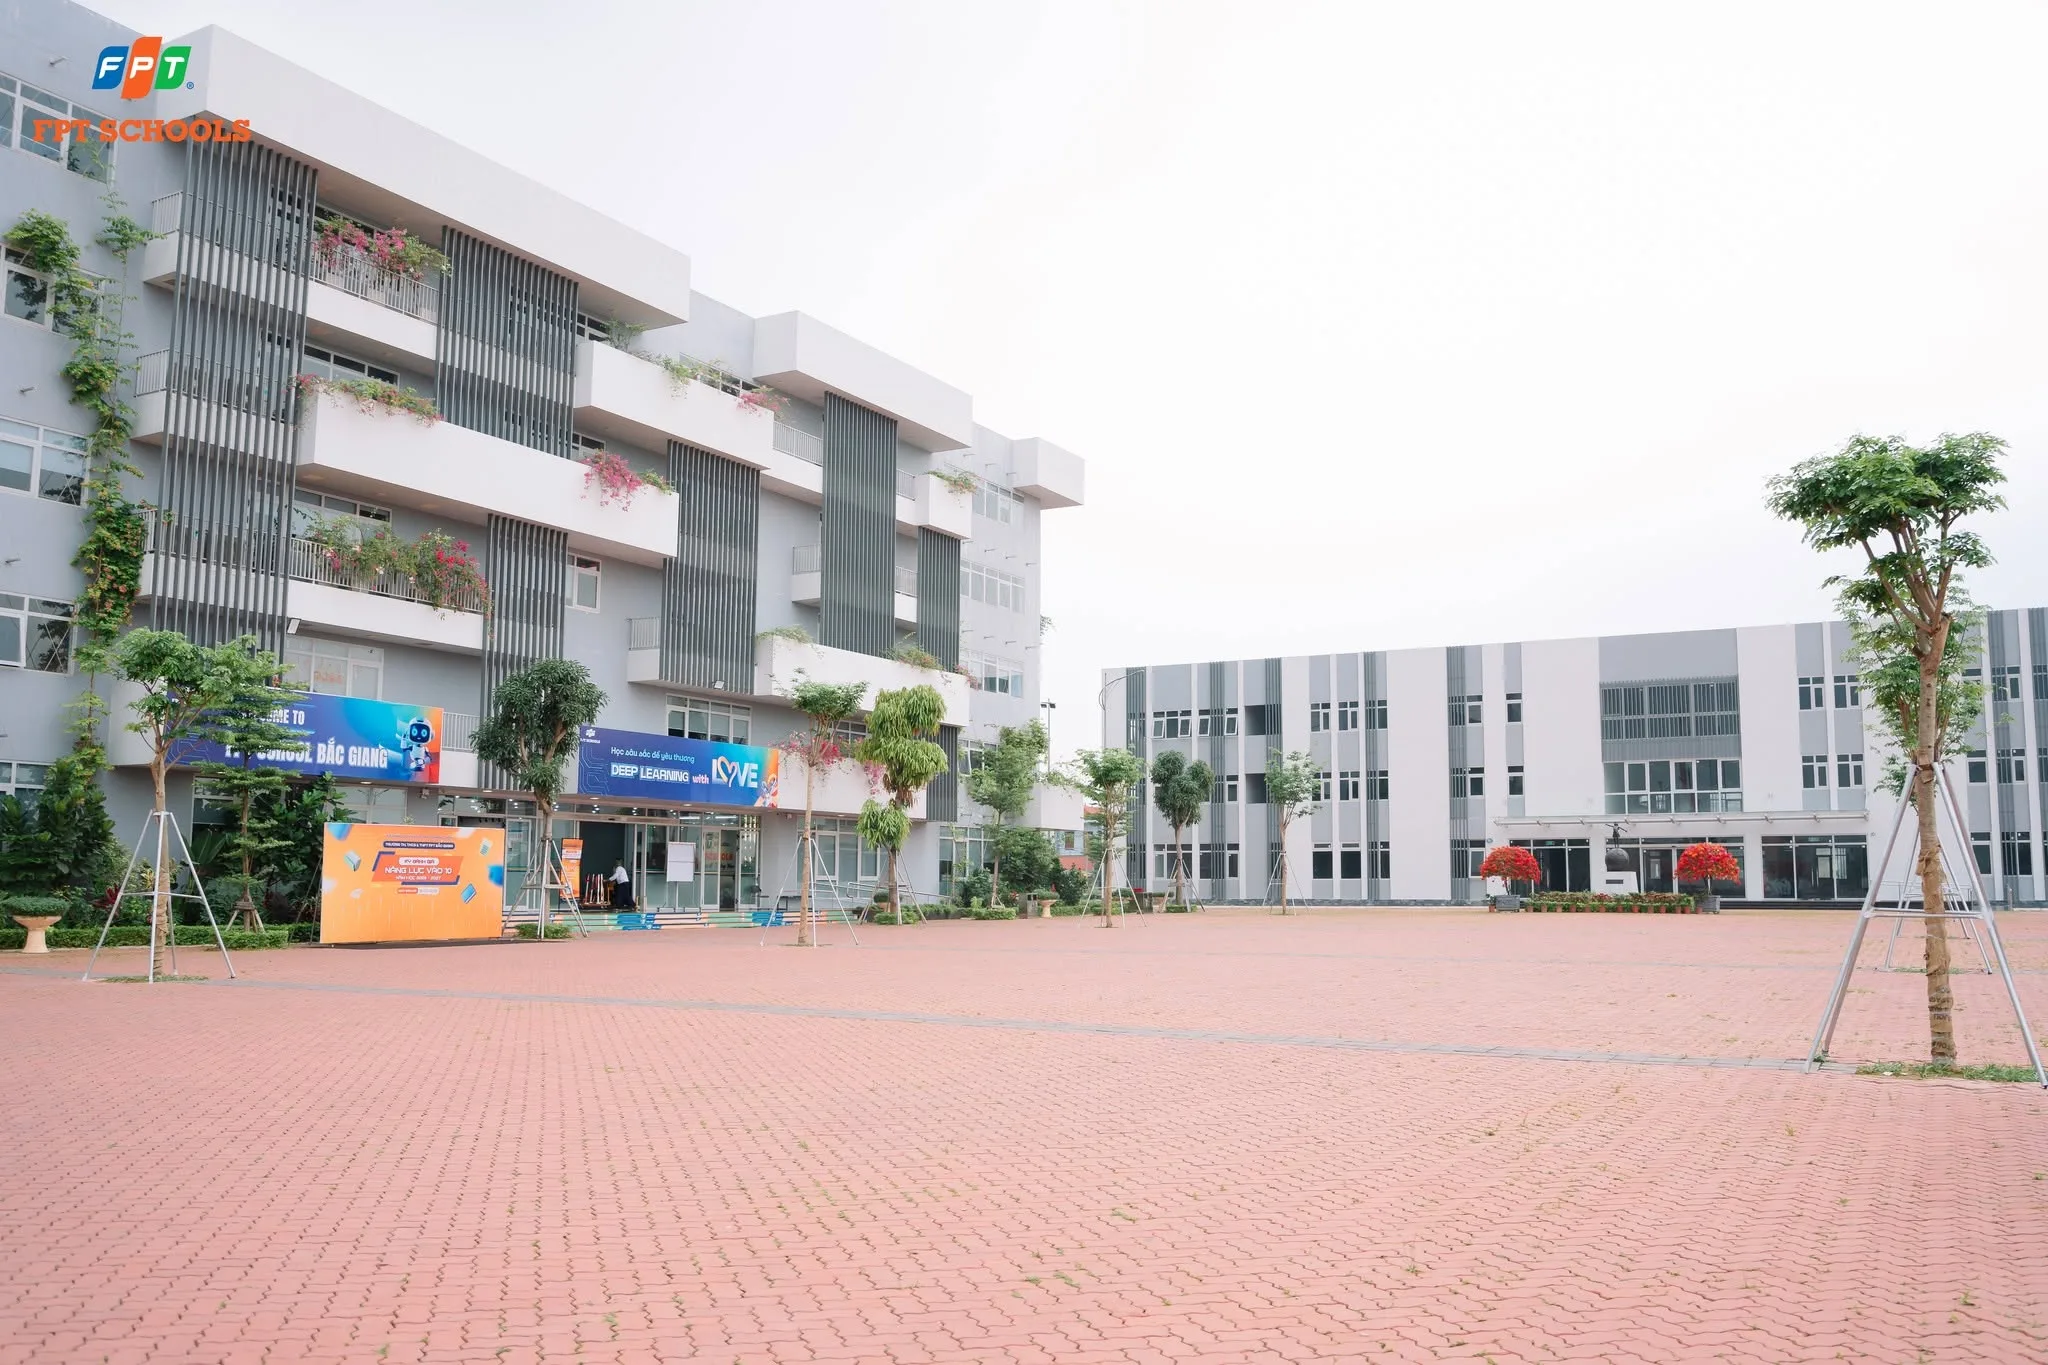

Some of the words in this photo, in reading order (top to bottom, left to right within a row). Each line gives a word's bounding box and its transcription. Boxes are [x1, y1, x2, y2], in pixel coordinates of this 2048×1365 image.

[293, 709, 305, 726] TO
[317, 737, 345, 765] BẮC
[348, 745, 388, 769] GIANG
[610, 746, 624, 757] Học
[611, 763, 638, 778] DEEP
[640, 766, 689, 783] LEARNING
[692, 774, 709, 784] with
